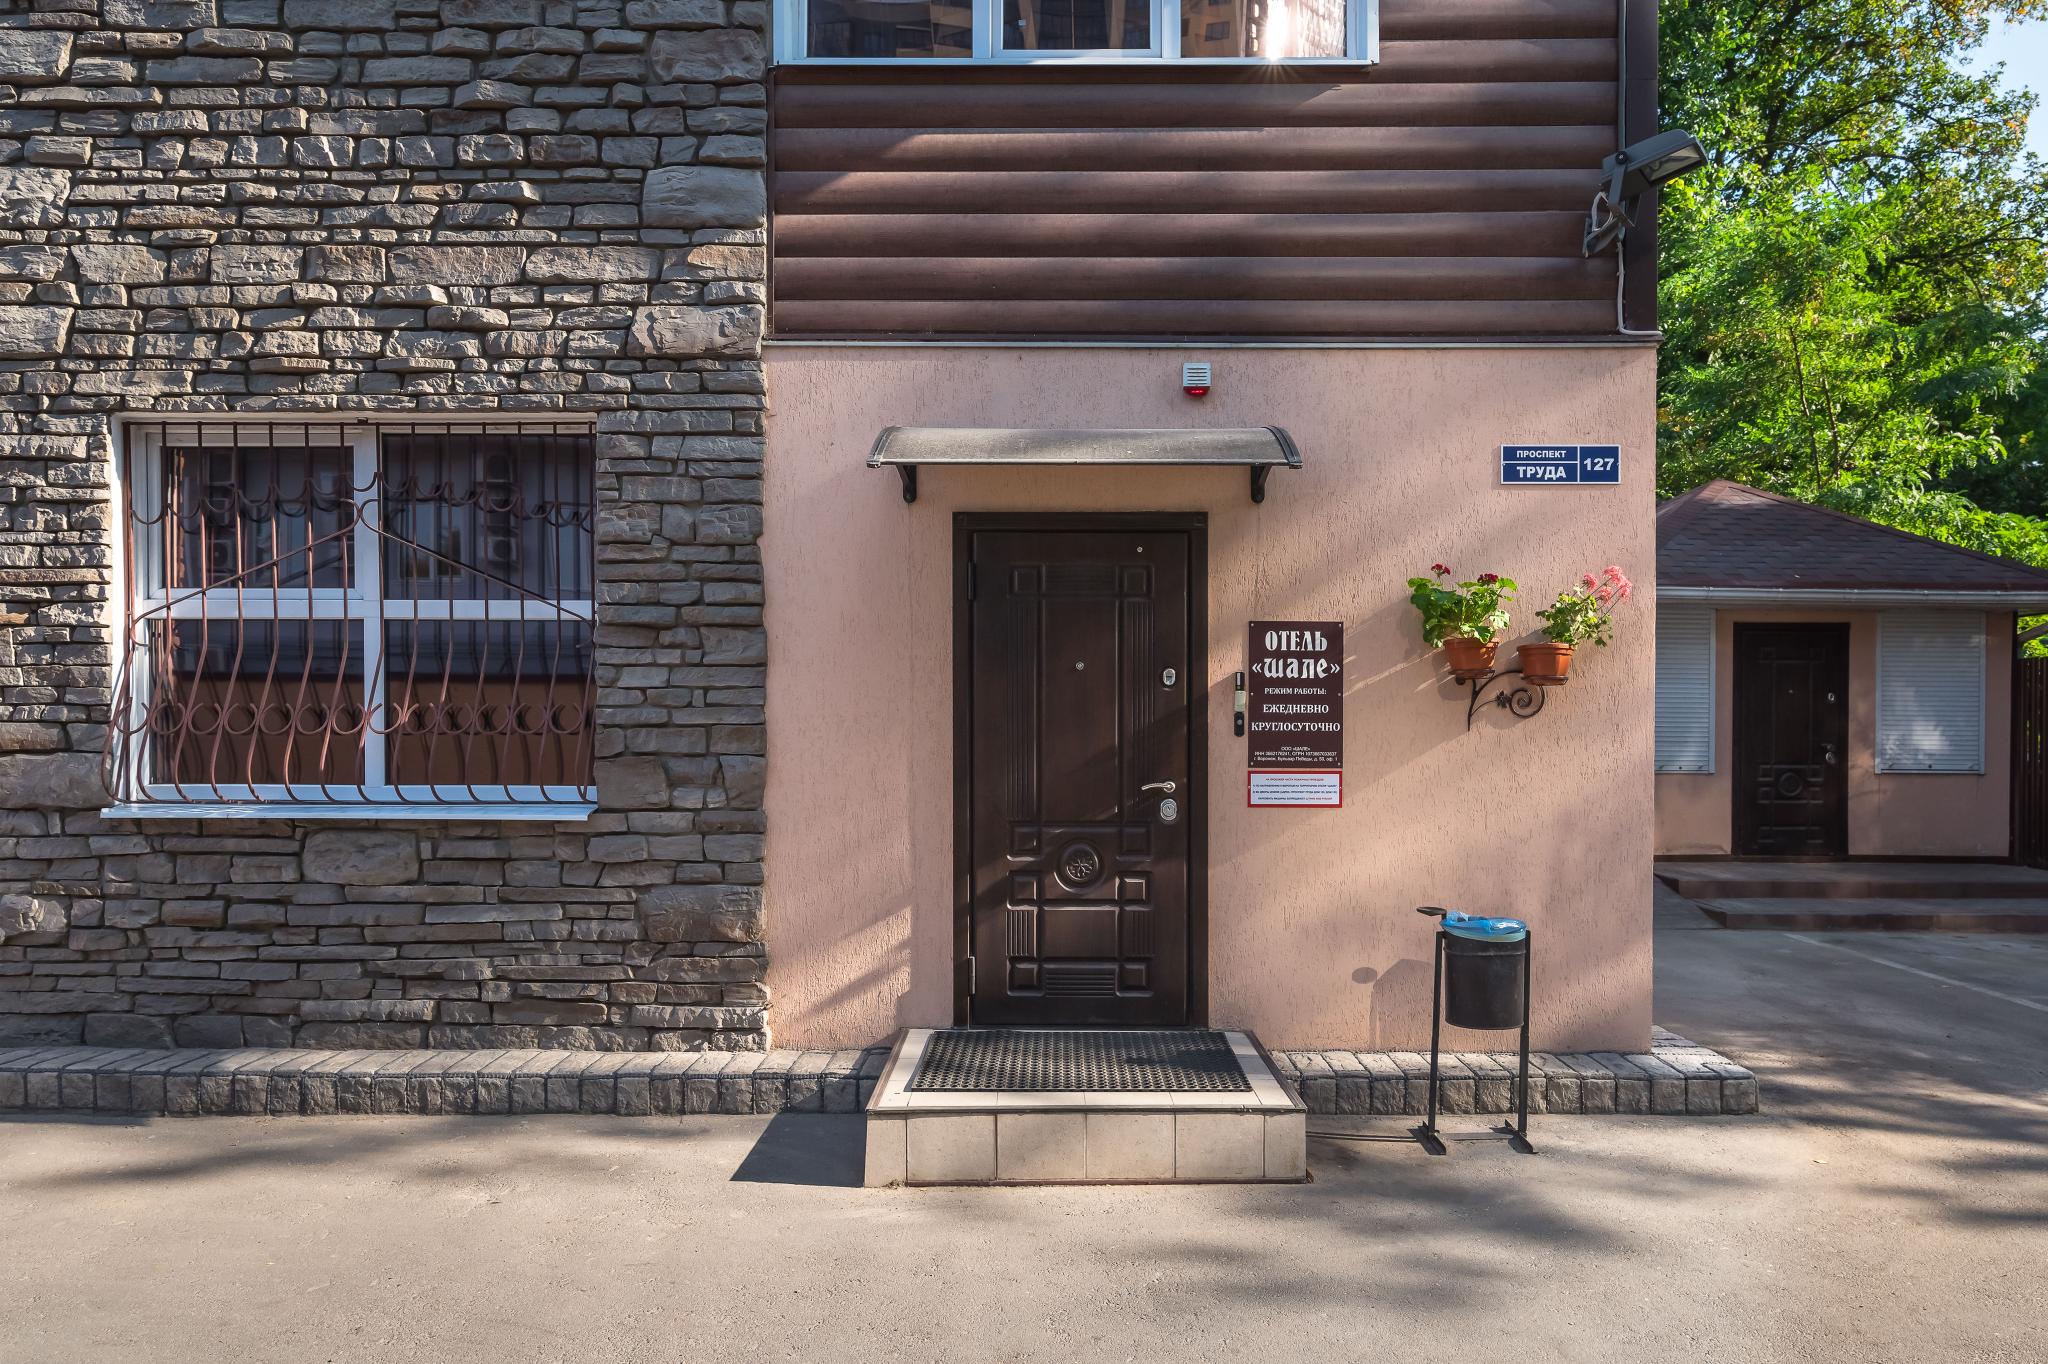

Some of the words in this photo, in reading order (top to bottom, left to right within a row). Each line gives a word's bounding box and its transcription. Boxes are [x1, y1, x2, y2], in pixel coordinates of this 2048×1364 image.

[1516, 450, 1566, 458] ПРОСПЕКТ
[1583, 457, 1615, 471] 127
[1516, 466, 1566, 480] ТРУДА
[1264, 630, 1328, 652] ОТЕЛЬ
[1264, 687, 1292, 695] РЕЖИМ
[1294, 687, 1327, 695] РАБОТЫ:
[1263, 704, 1329, 714] ЕЖЕДНЕВНО
[1251, 722, 1341, 732] КРУГЛОСУТОЧНО
